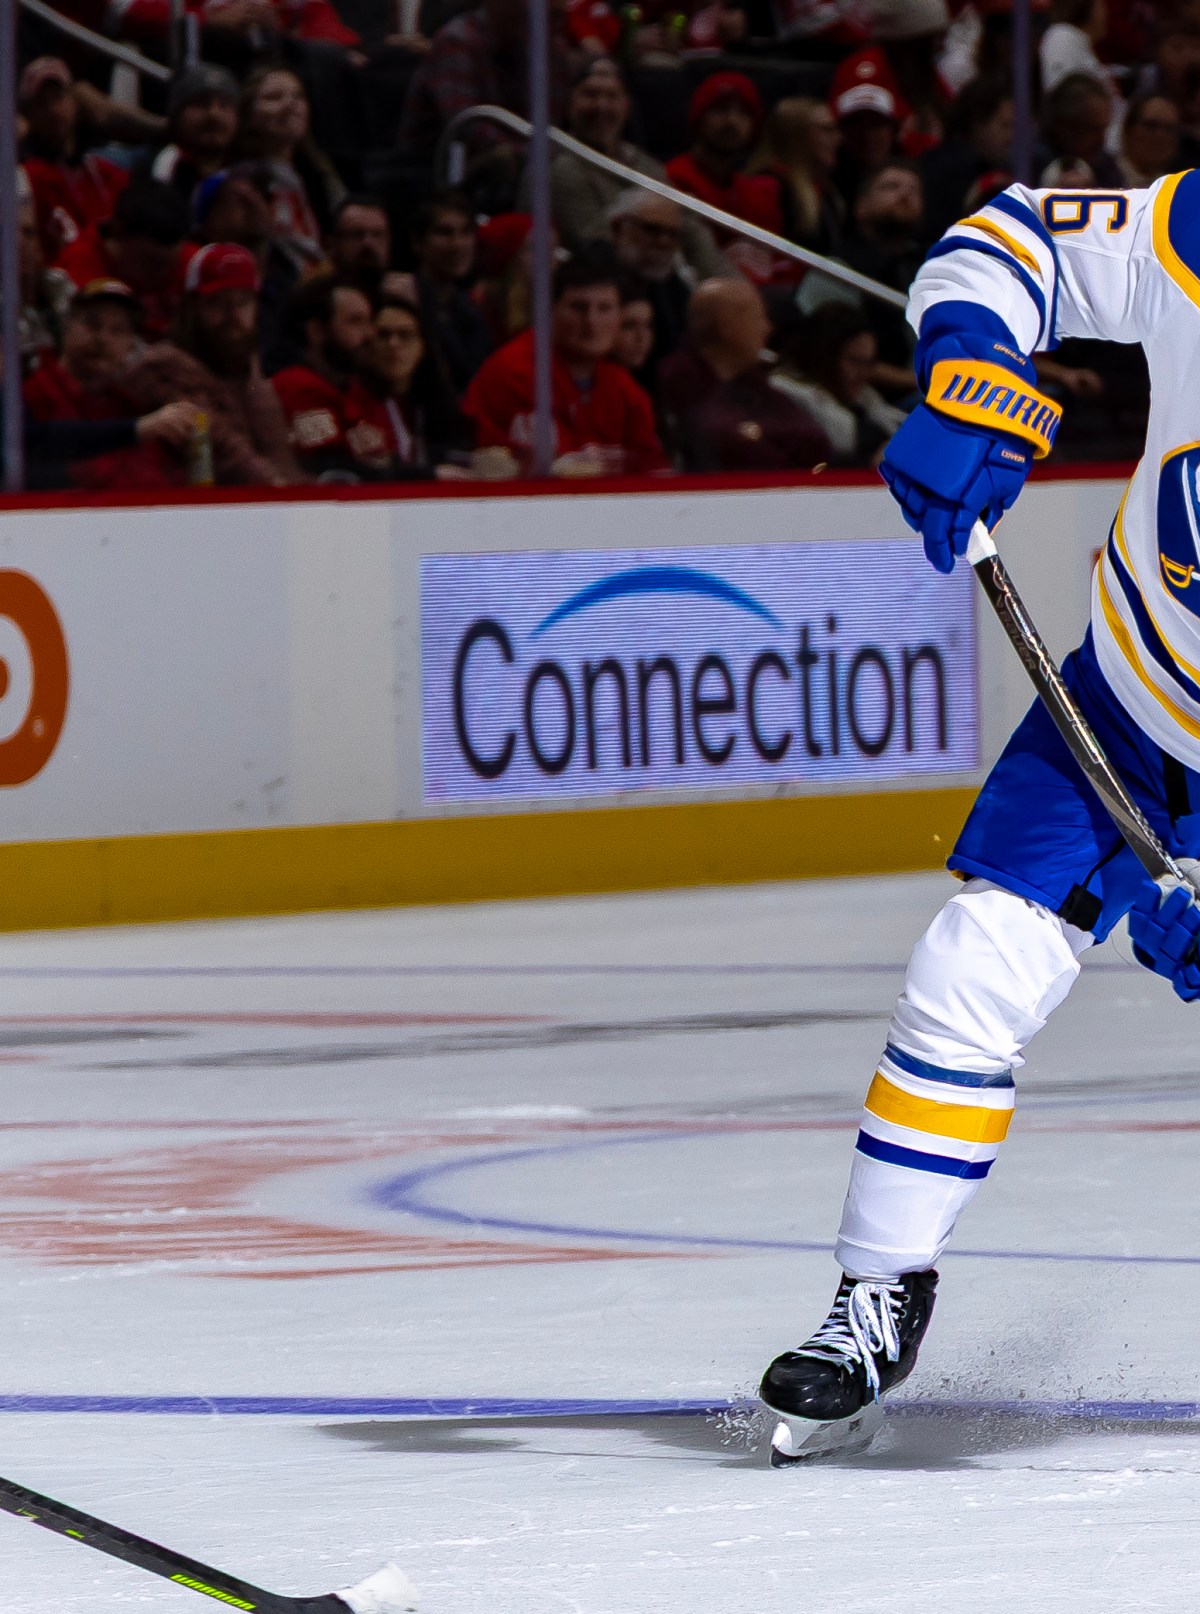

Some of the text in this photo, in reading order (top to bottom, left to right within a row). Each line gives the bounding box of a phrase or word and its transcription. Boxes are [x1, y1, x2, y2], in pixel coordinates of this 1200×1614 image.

[1040, 189, 1131, 235] 6
[940, 373, 1061, 446] WARRI
[453, 616, 949, 779] Connection
